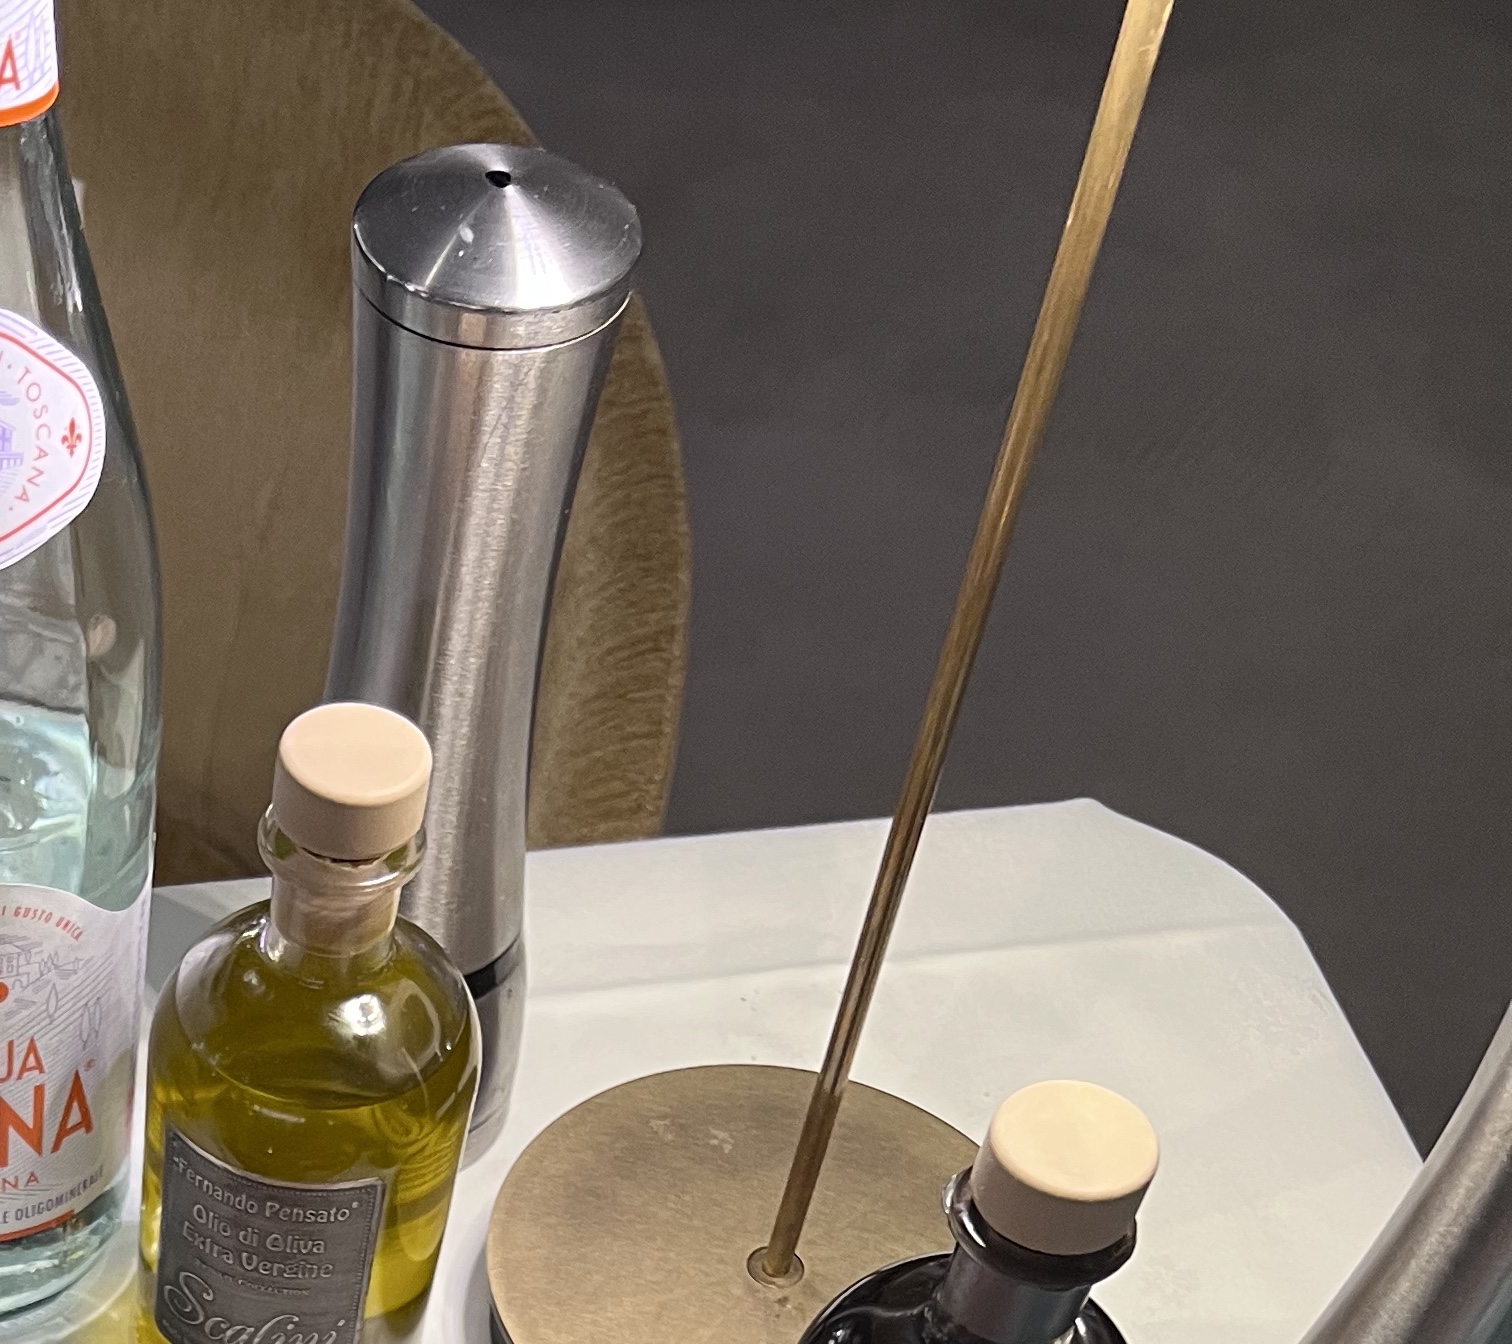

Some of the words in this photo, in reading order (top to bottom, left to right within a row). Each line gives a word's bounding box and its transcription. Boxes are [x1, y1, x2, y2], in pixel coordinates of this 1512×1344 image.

[15, 367, 51, 503] TOSCANA
[13, 906, 53, 924] GUSTO
[182, 1221, 235, 1265] Extra
[241, 1252, 334, 1279] Vergine
[193, 1204, 232, 1237] Olio
[238, 1227, 259, 1247] di
[266, 1233, 326, 1255] Oliva
